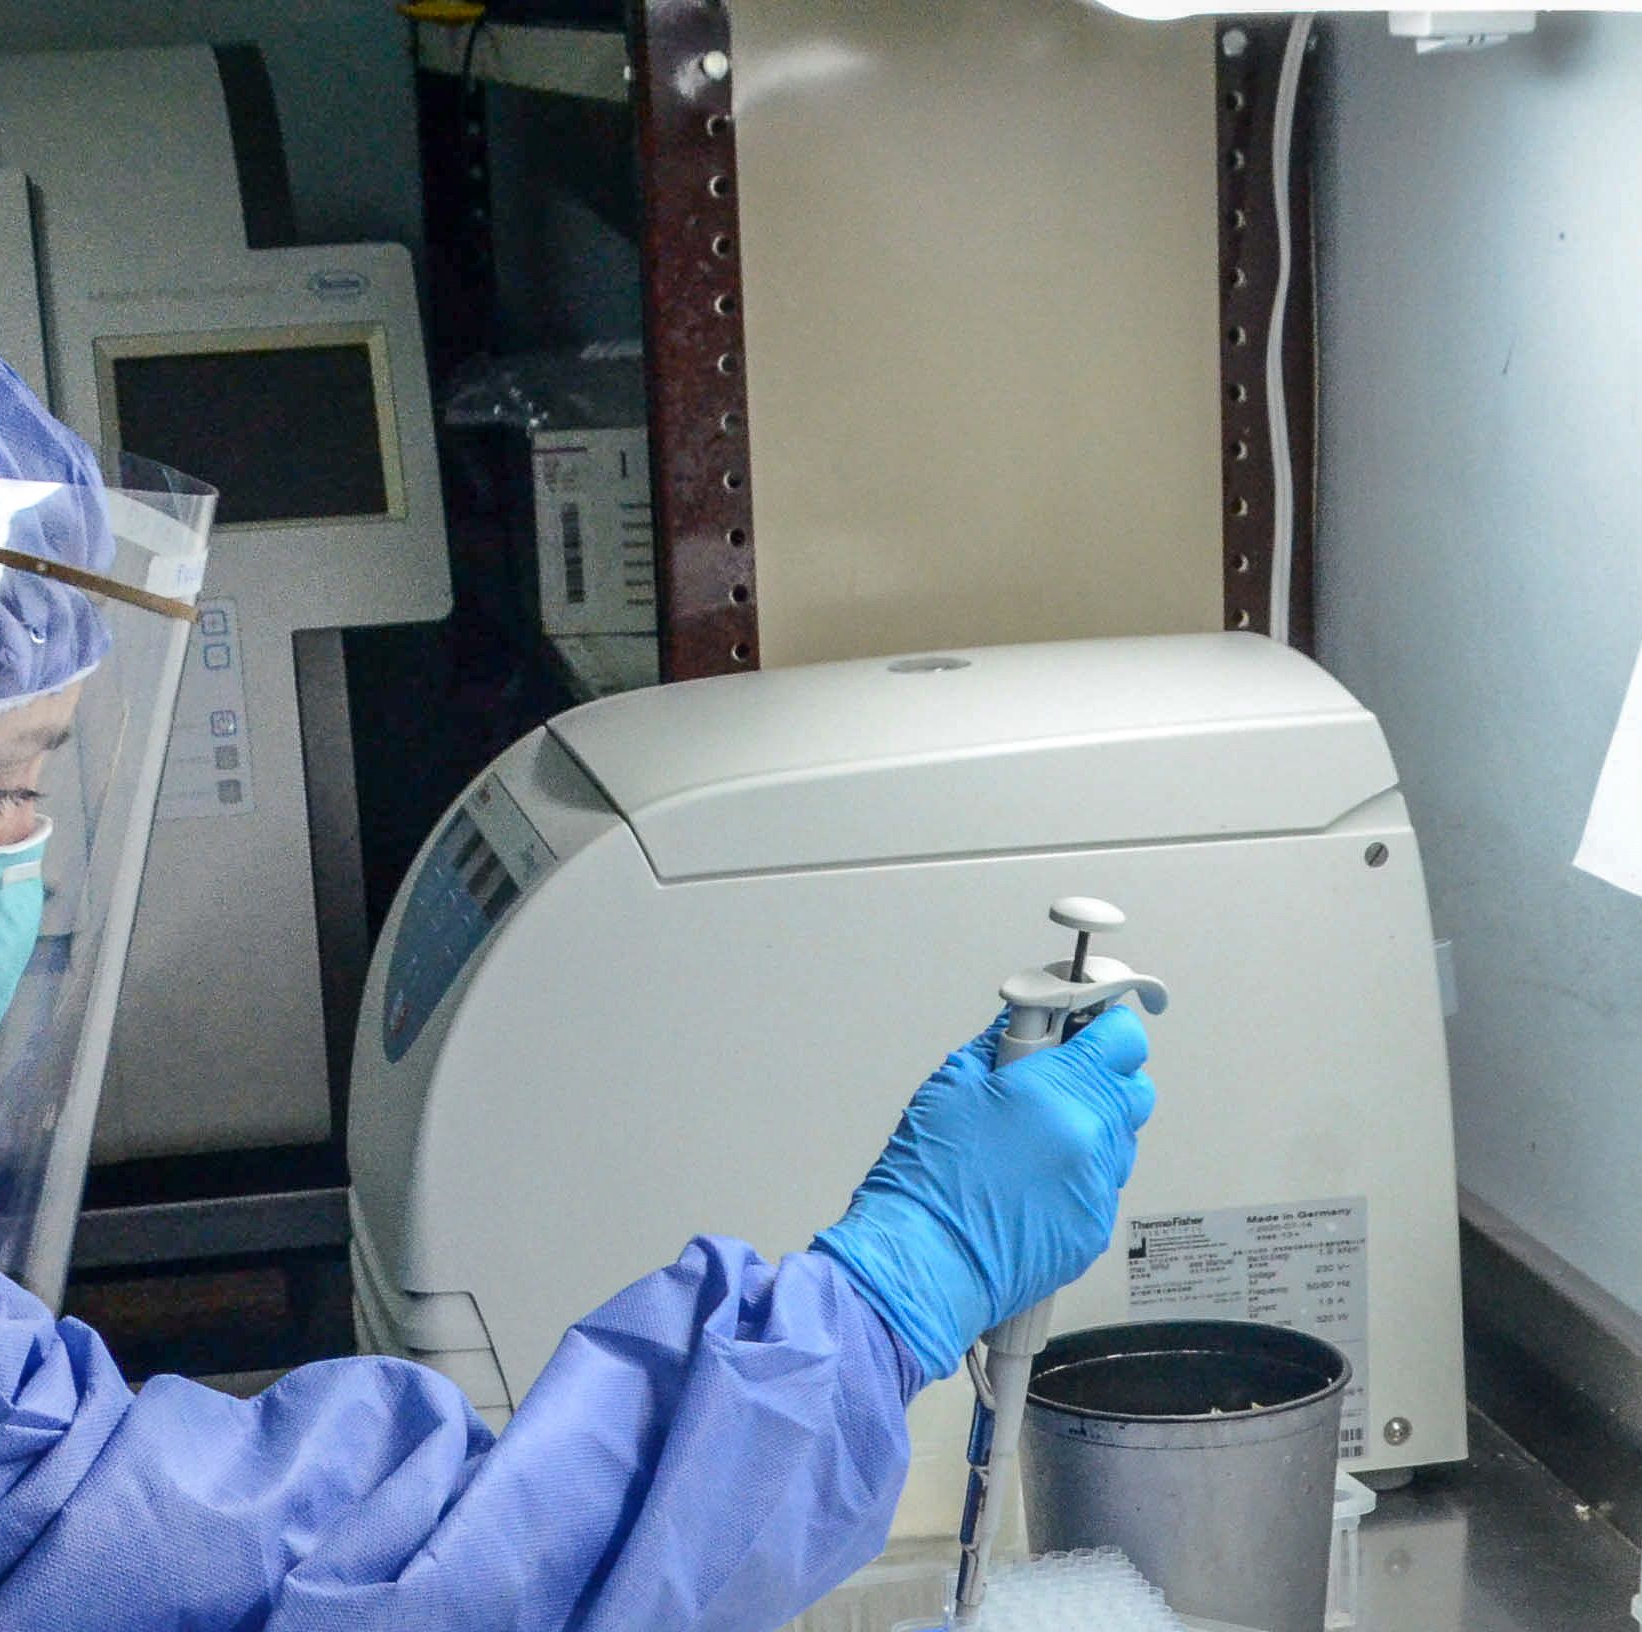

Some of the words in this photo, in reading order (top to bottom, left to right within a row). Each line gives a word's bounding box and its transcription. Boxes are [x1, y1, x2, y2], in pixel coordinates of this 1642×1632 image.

[1131, 1216, 1205, 1230] ThermoFisher
[1246, 1215, 1279, 1224] Made
[1283, 1213, 1294, 1221] in
[1297, 1207, 1352, 1220] Germany
